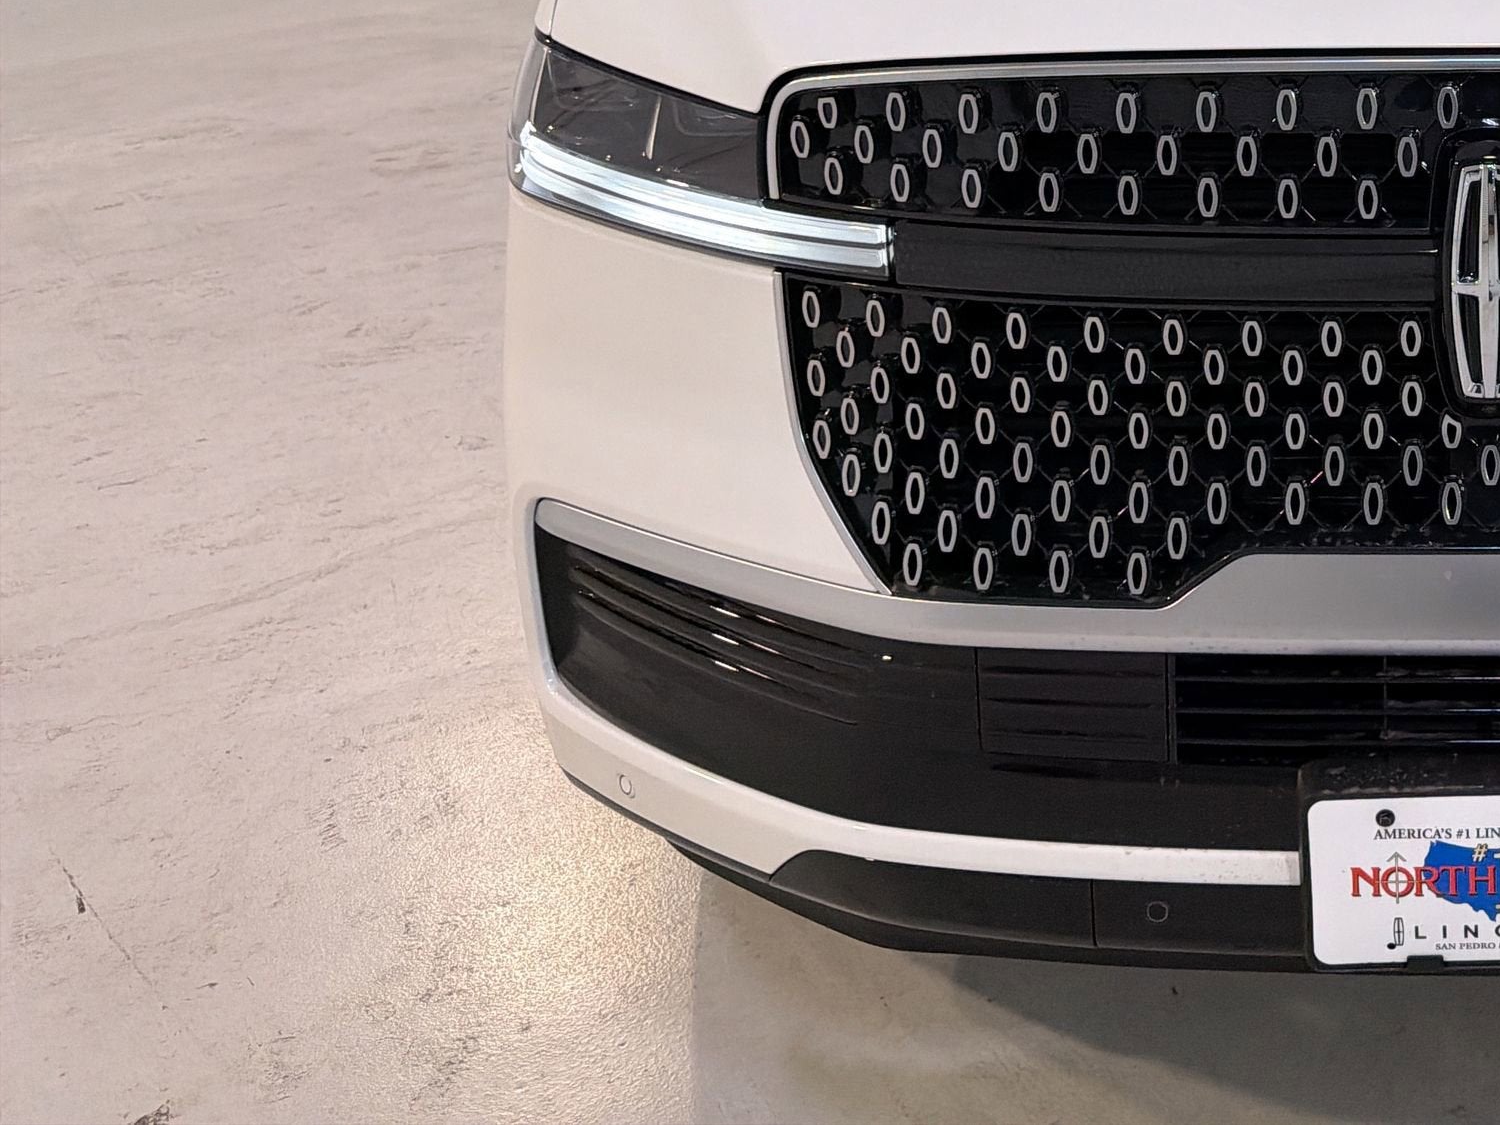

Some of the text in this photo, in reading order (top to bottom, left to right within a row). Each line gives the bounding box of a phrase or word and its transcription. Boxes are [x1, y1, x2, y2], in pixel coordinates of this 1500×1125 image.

[1373, 826, 1453, 840] AMERICA'S
[1456, 828, 1471, 839] #1
[1350, 866, 1496, 897] NORTH
[1435, 942, 1457, 950] SAN
[1459, 941, 1496, 950] PEDRO
